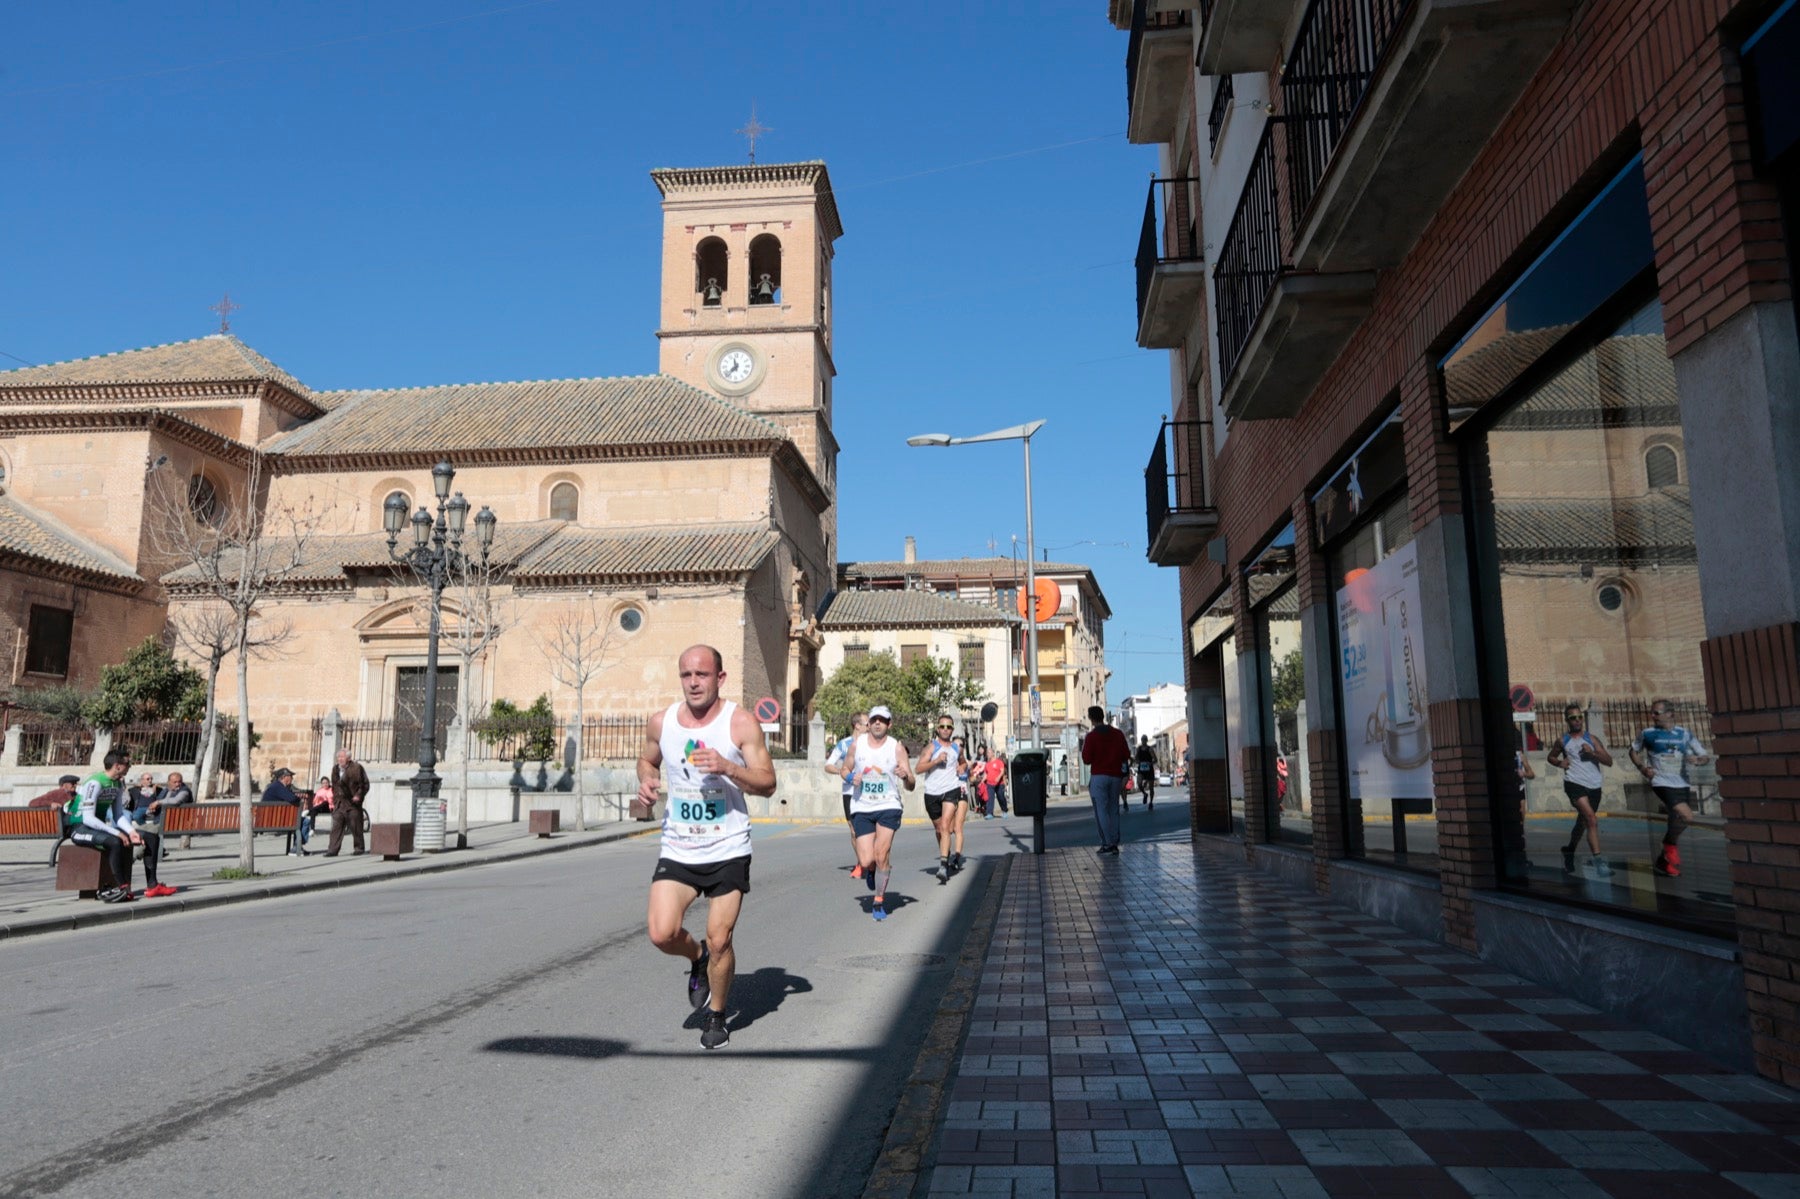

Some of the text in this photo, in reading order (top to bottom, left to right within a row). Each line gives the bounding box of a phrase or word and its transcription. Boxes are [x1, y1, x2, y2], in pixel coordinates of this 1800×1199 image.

[1399, 600, 1408, 629] 5G
[865, 782, 884, 793] 528
[681, 802, 717, 821] 805
